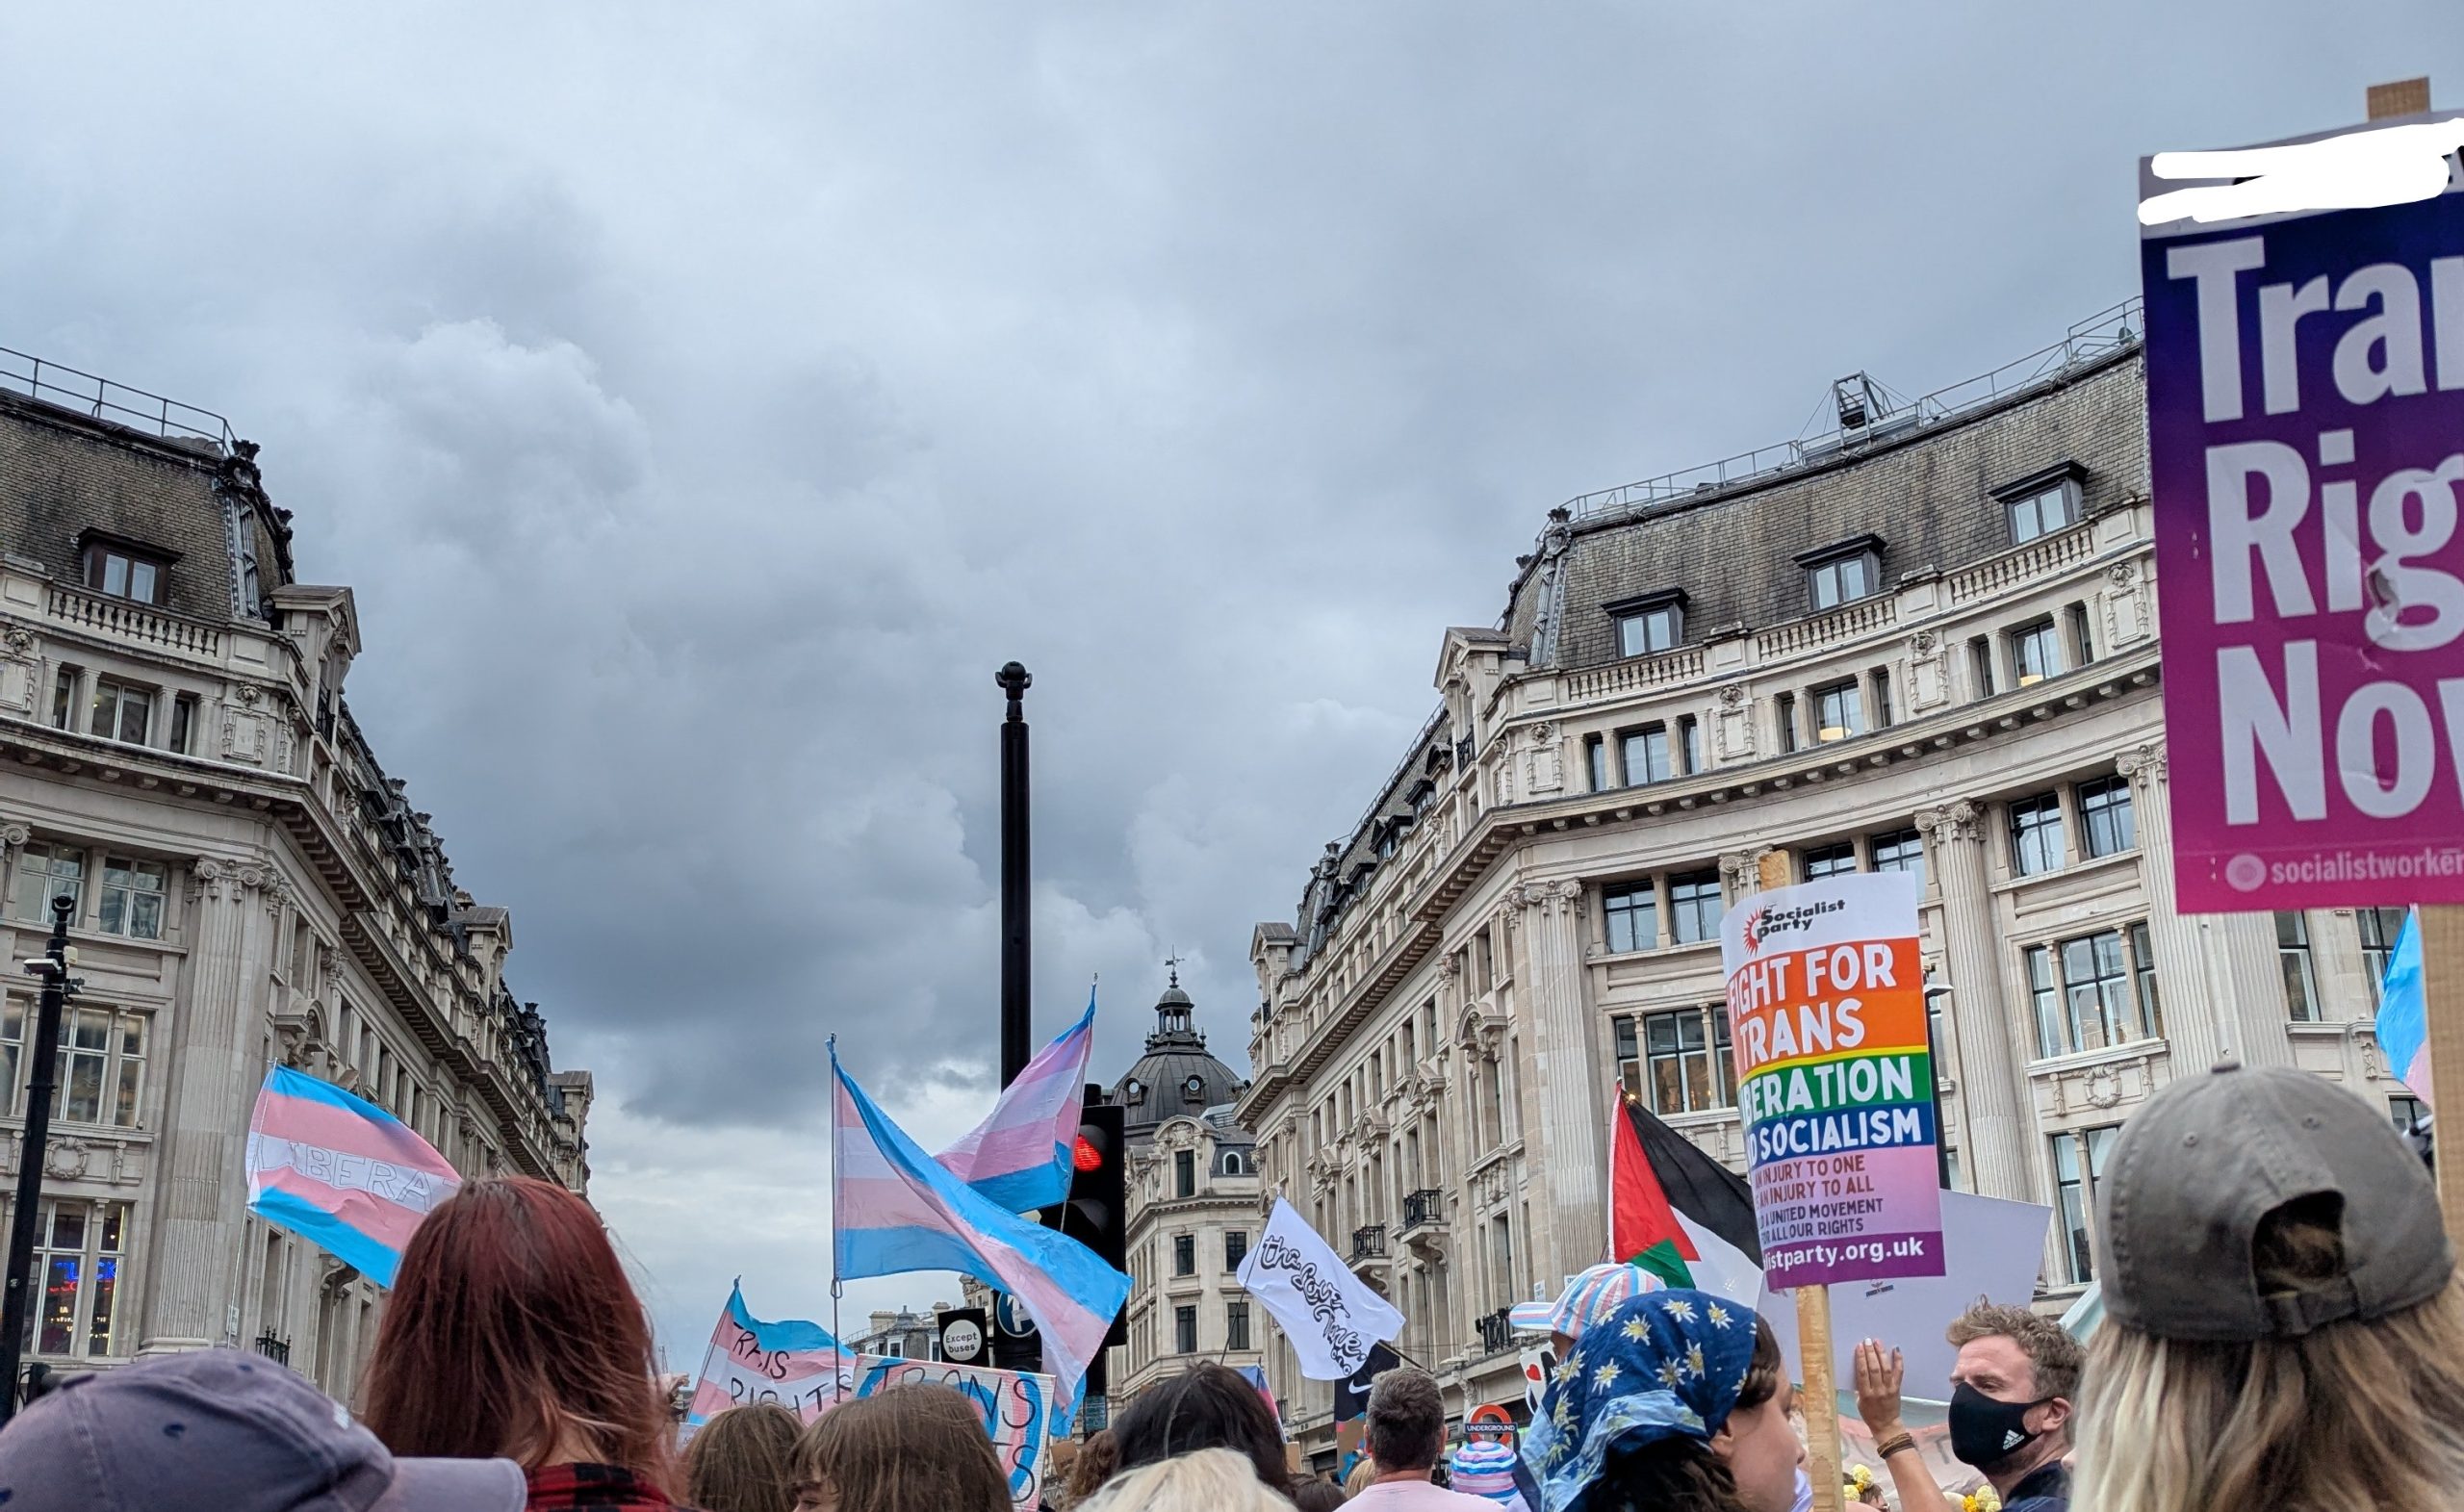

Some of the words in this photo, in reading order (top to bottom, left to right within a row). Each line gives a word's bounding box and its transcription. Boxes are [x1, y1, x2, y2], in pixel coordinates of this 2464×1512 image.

[1760, 899, 1845, 926] Socialist
[1757, 917, 1813, 943] party
[1729, 956, 1791, 1025] FIGHT
[1805, 943, 1897, 997] FOR
[1739, 997, 1865, 1071] TRANS
[1759, 1107, 1922, 1161] SOCIALISM
[257, 1134, 458, 1212] LIBERA
[1763, 1160, 1803, 1185] INJURY
[1807, 1159, 1828, 1177] TO
[1833, 1154, 1865, 1174] ONE
[1771, 1181, 1815, 1205] INJURY
[1821, 1179, 1841, 1197] TO
[1846, 1175, 1875, 1194] ALL
[1771, 1205, 1807, 1224] UNITED
[1810, 1198, 1884, 1218] MOVEMENT
[1771, 1226, 1788, 1242] ALL
[1790, 1222, 1813, 1239] OUR
[1818, 1217, 1864, 1236] RIGHTS
[1763, 1237, 1925, 1272] listparty.org.uk
[945, 1331, 978, 1344] Except
[948, 1344, 977, 1353] buses
